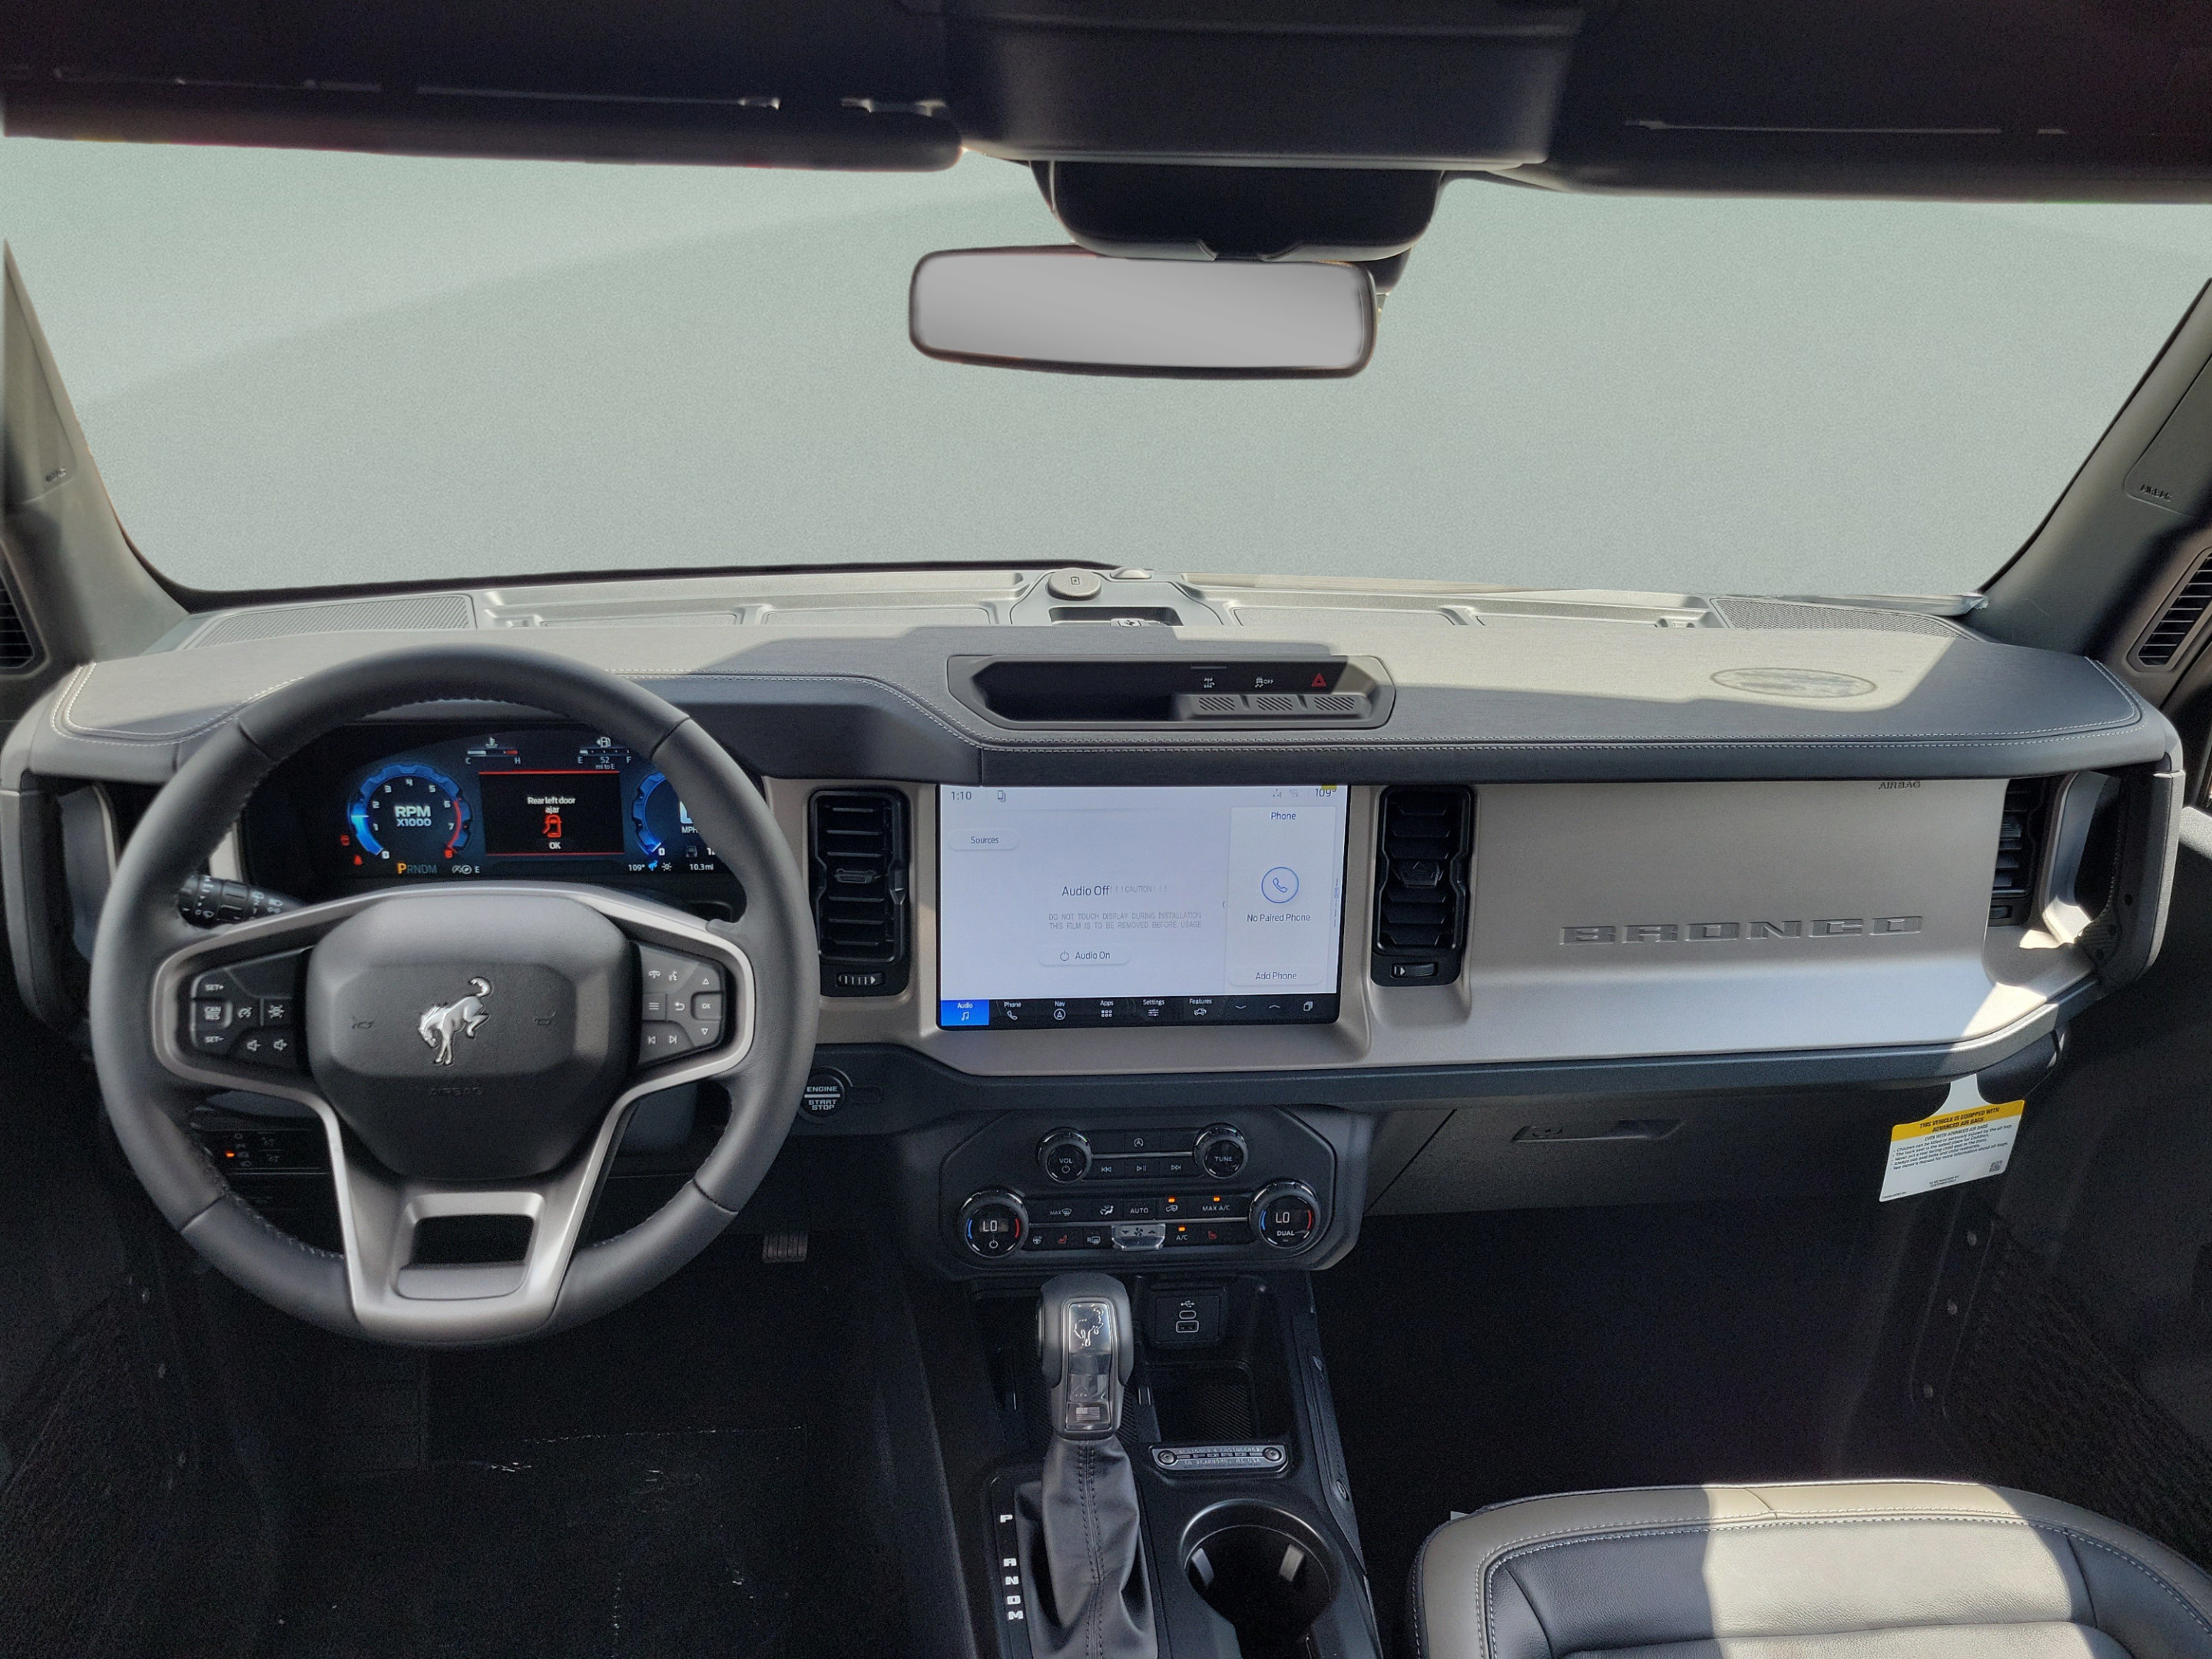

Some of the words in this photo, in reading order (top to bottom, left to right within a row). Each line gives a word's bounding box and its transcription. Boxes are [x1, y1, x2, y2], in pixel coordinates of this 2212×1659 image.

[1879, 781, 1921, 790] AIRBAG
[951, 791, 972, 800] 1:10
[395, 806, 431, 818] RPM
[396, 818, 432, 827] X1000
[1062, 886, 1091, 896] Audio
[1094, 886, 1110, 896] Off
[1260, 913, 1284, 922] Paired
[1559, 916, 1923, 945] BRONCO
[1961, 1111, 1985, 1119] EQUIPPED
[1932, 1123, 1959, 1132] ADVANCED
[1276, 1212, 1290, 1223] LO
[982, 1220, 998, 1232] LO
[1005, 1576, 1018, 1584] N
[1007, 1595, 1021, 1604] D
[1008, 1611, 1024, 1620] M
